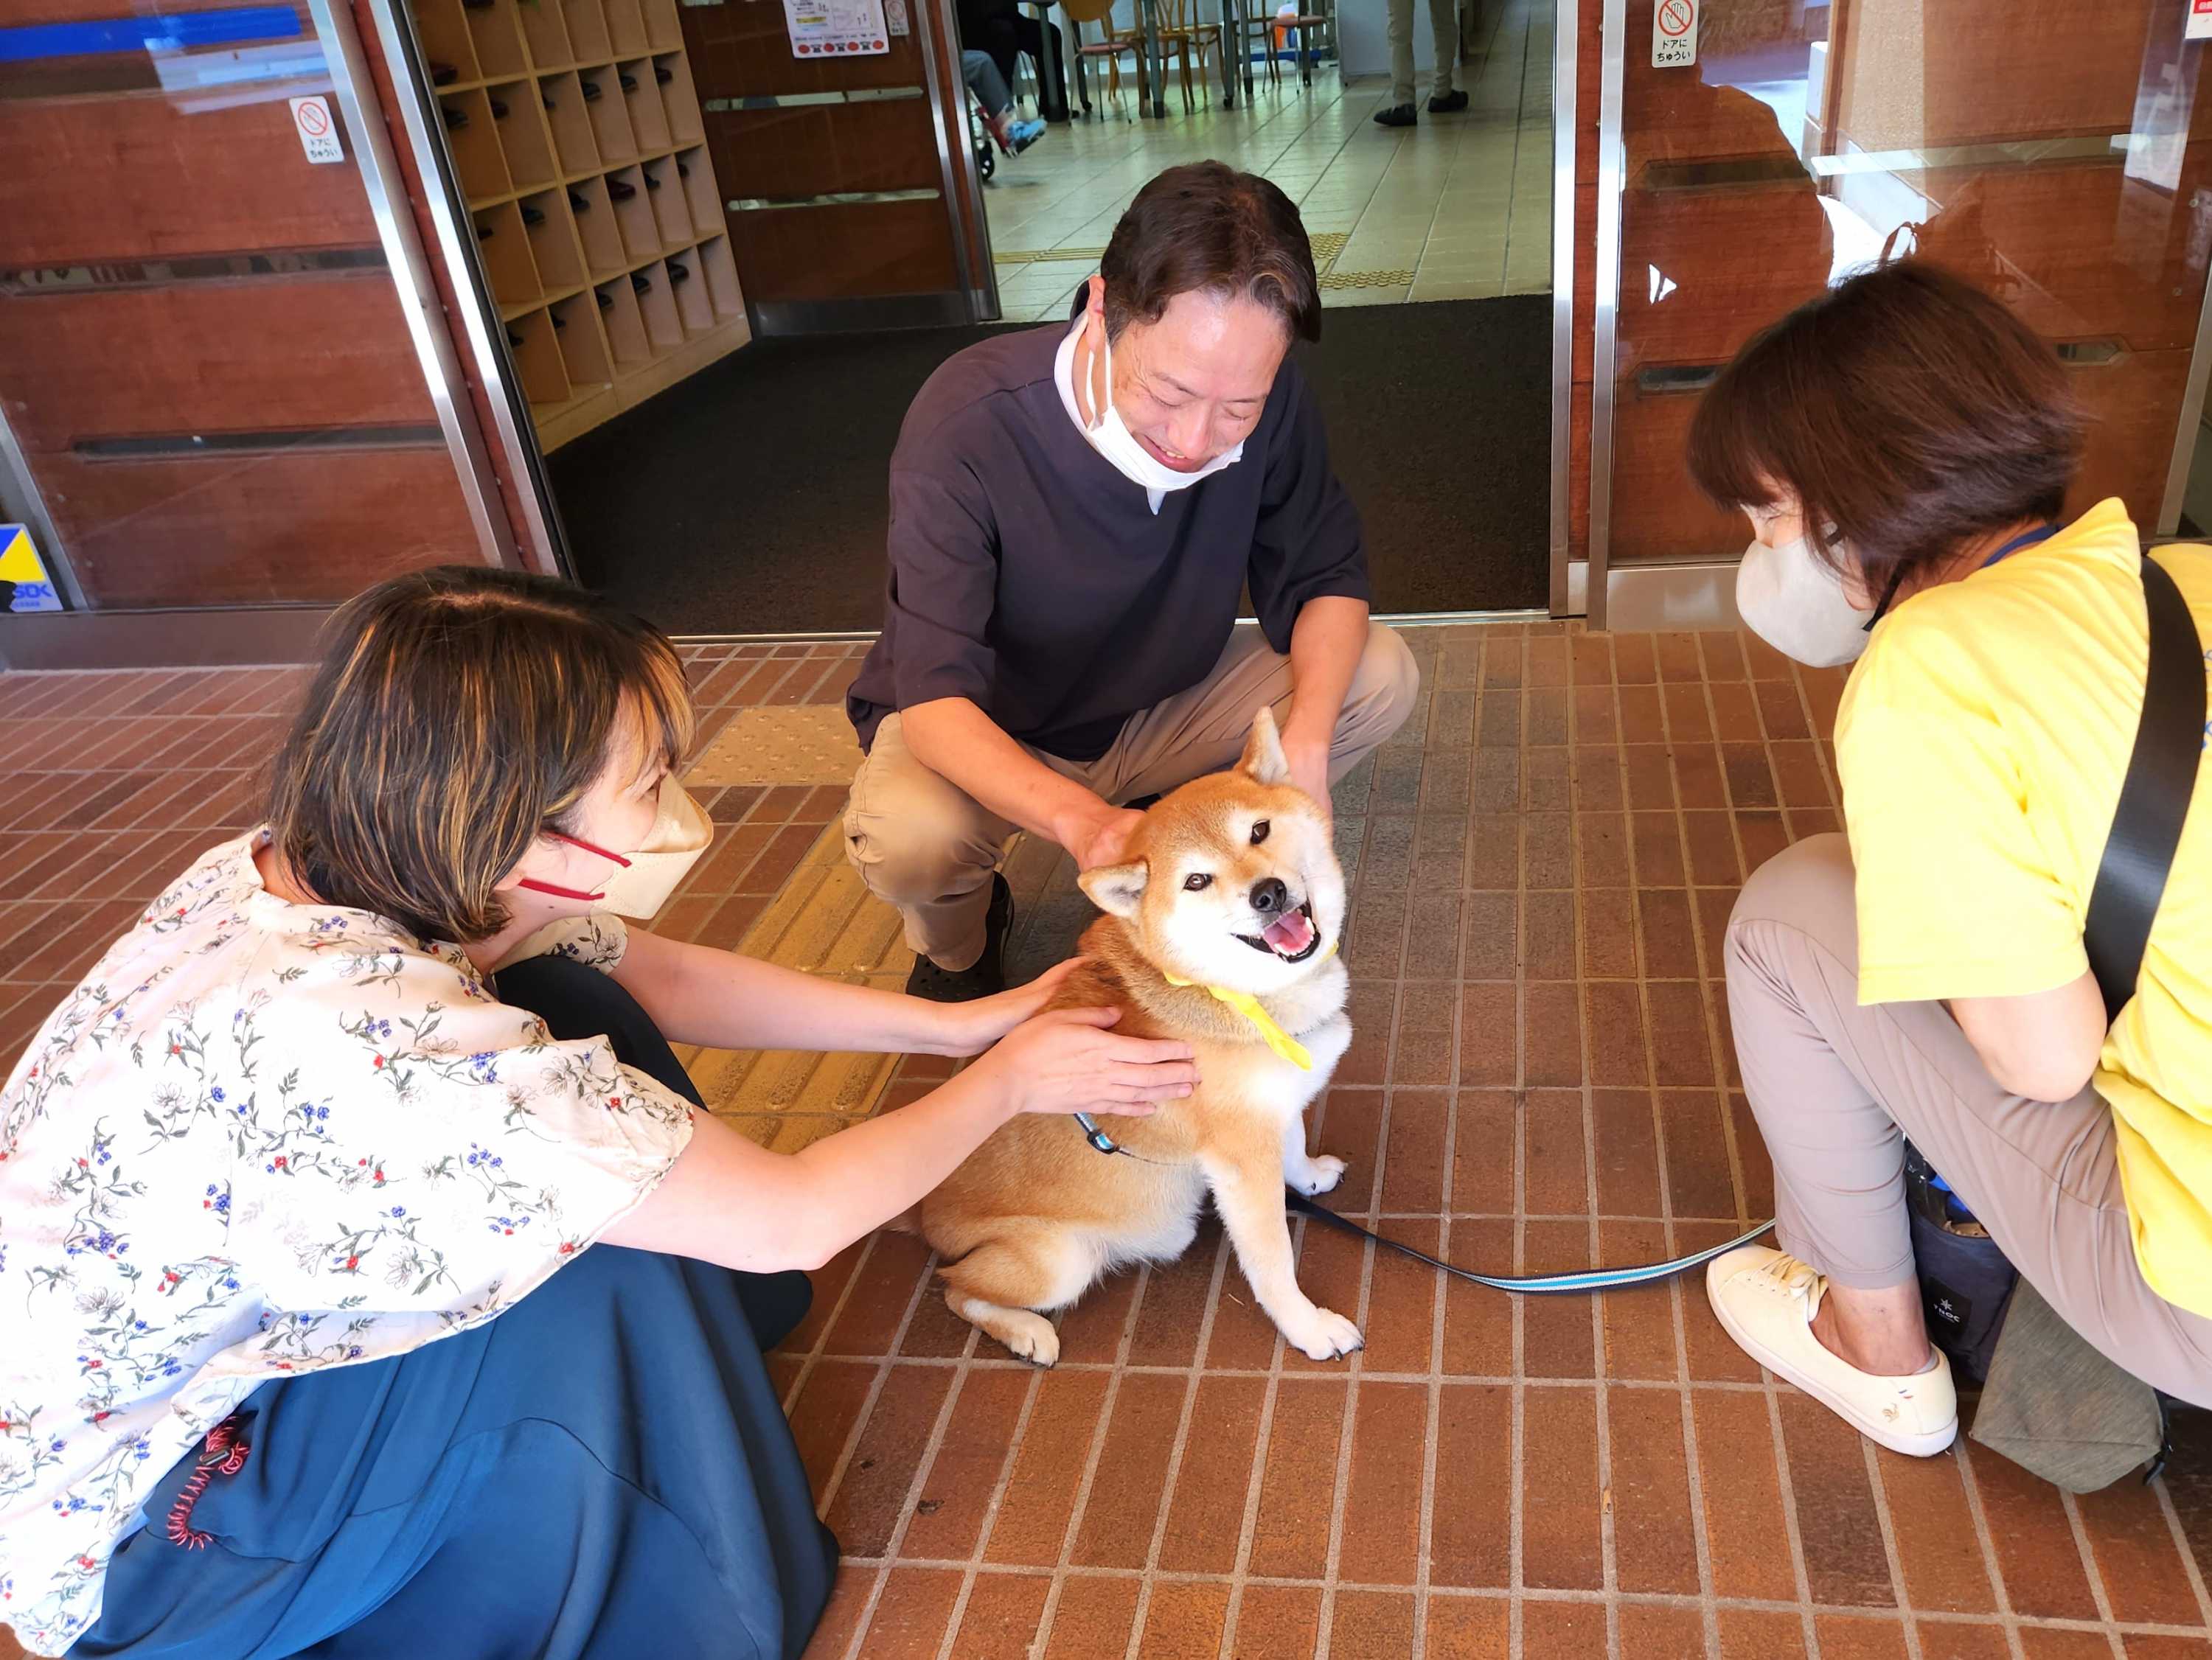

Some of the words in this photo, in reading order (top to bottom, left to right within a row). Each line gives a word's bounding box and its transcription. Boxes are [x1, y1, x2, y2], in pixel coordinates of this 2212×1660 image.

[1663, 39, 1687, 49] ドアに
[1657, 51, 1691, 62] ちゅうい
